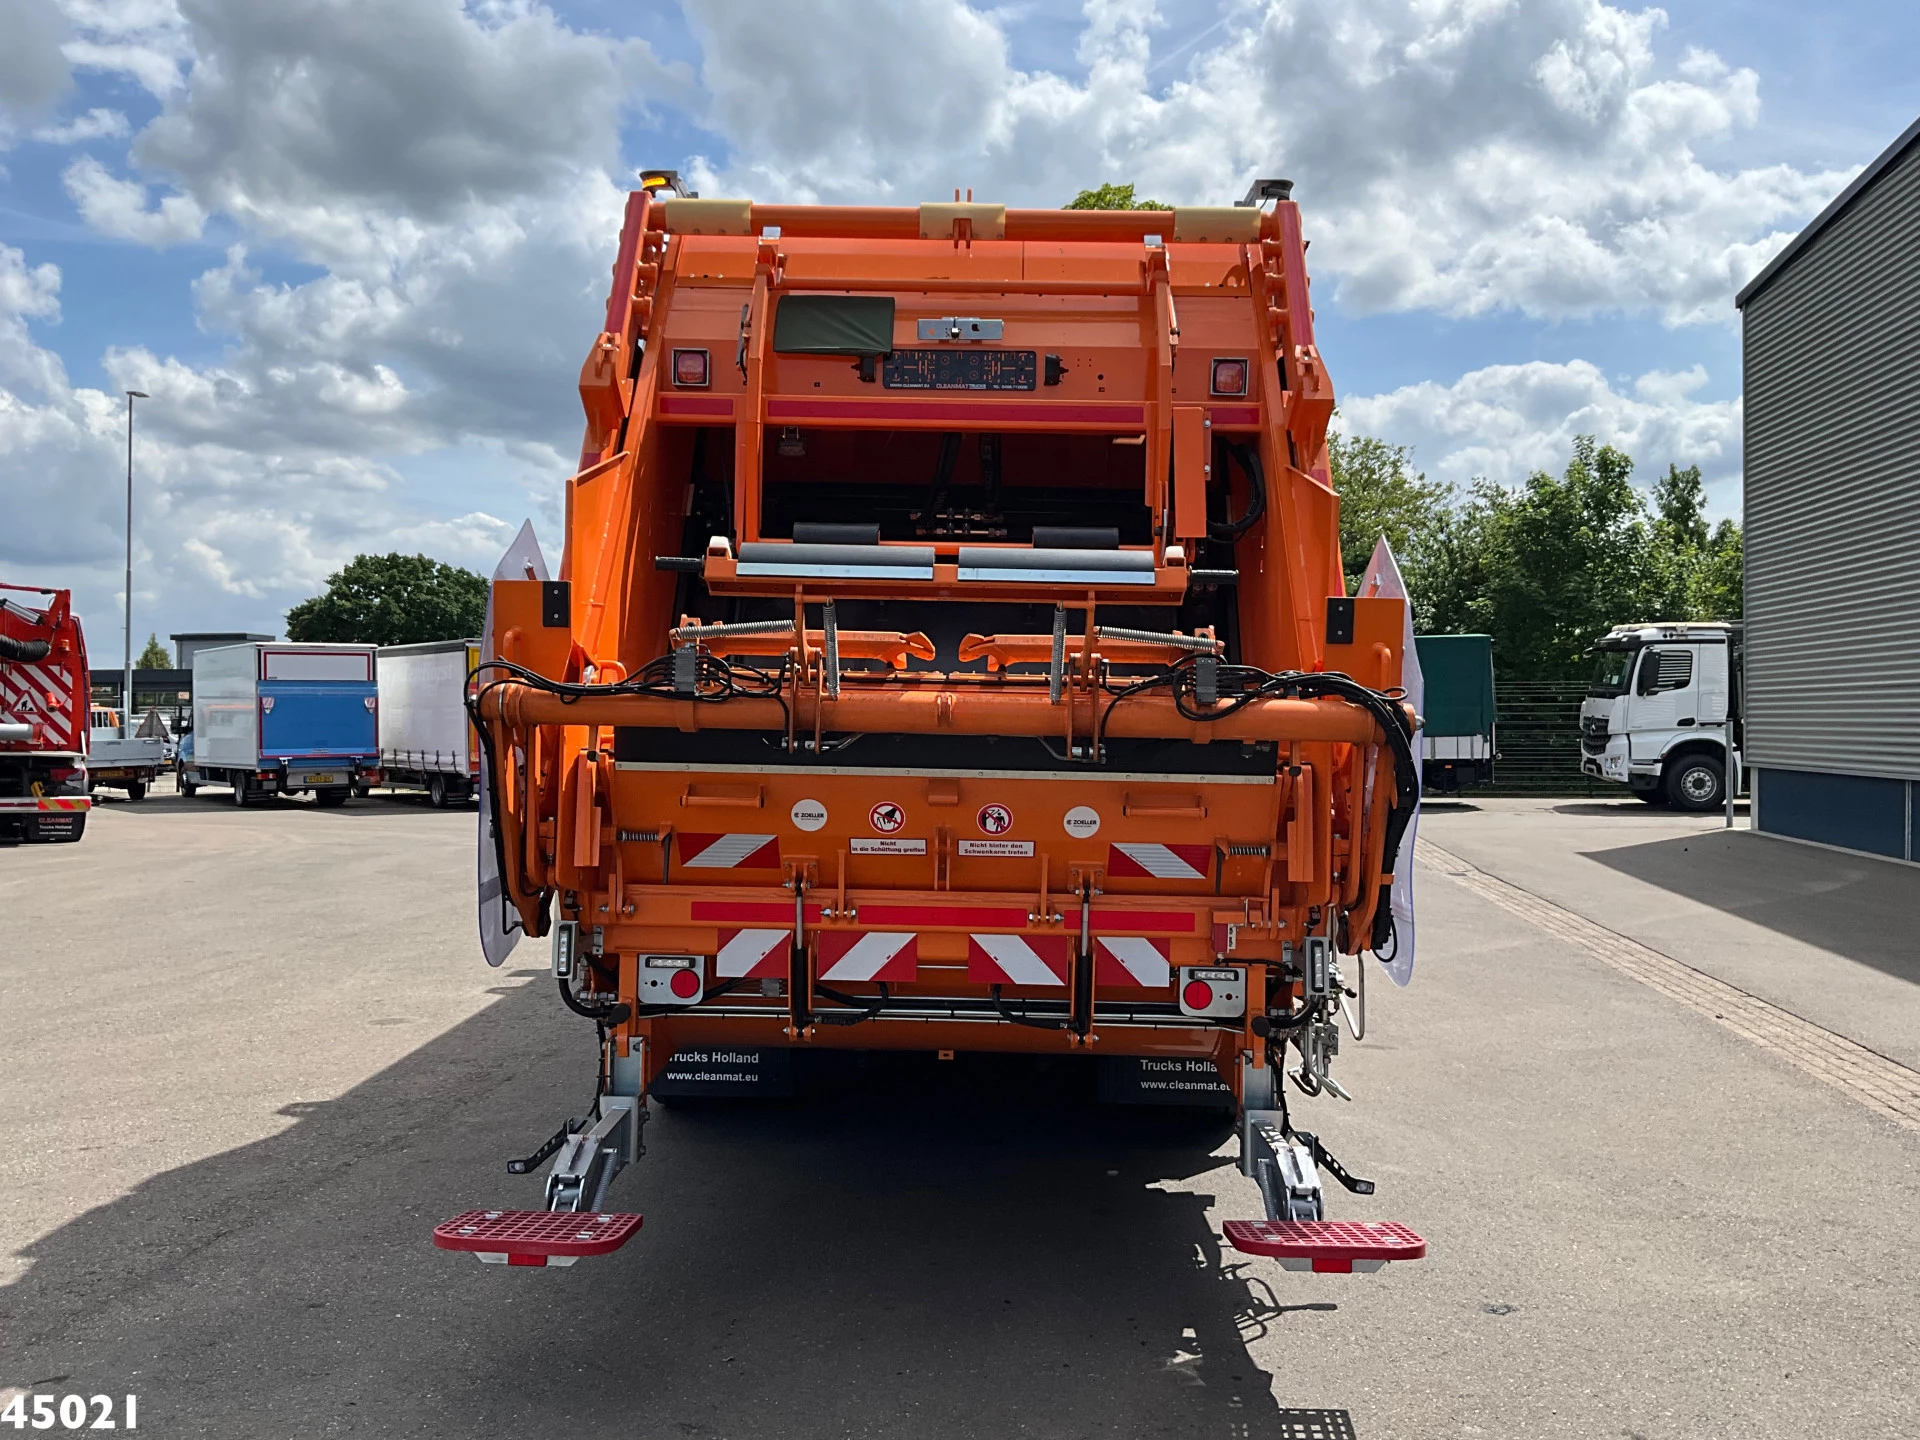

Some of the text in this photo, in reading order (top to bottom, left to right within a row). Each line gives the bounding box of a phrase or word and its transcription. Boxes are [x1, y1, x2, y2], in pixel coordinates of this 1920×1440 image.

[670, 1051, 759, 1064] rucks Holland
[1140, 1059, 1182, 1071] Trucks
[667, 1071, 759, 1082] www.cleanmat.eu
